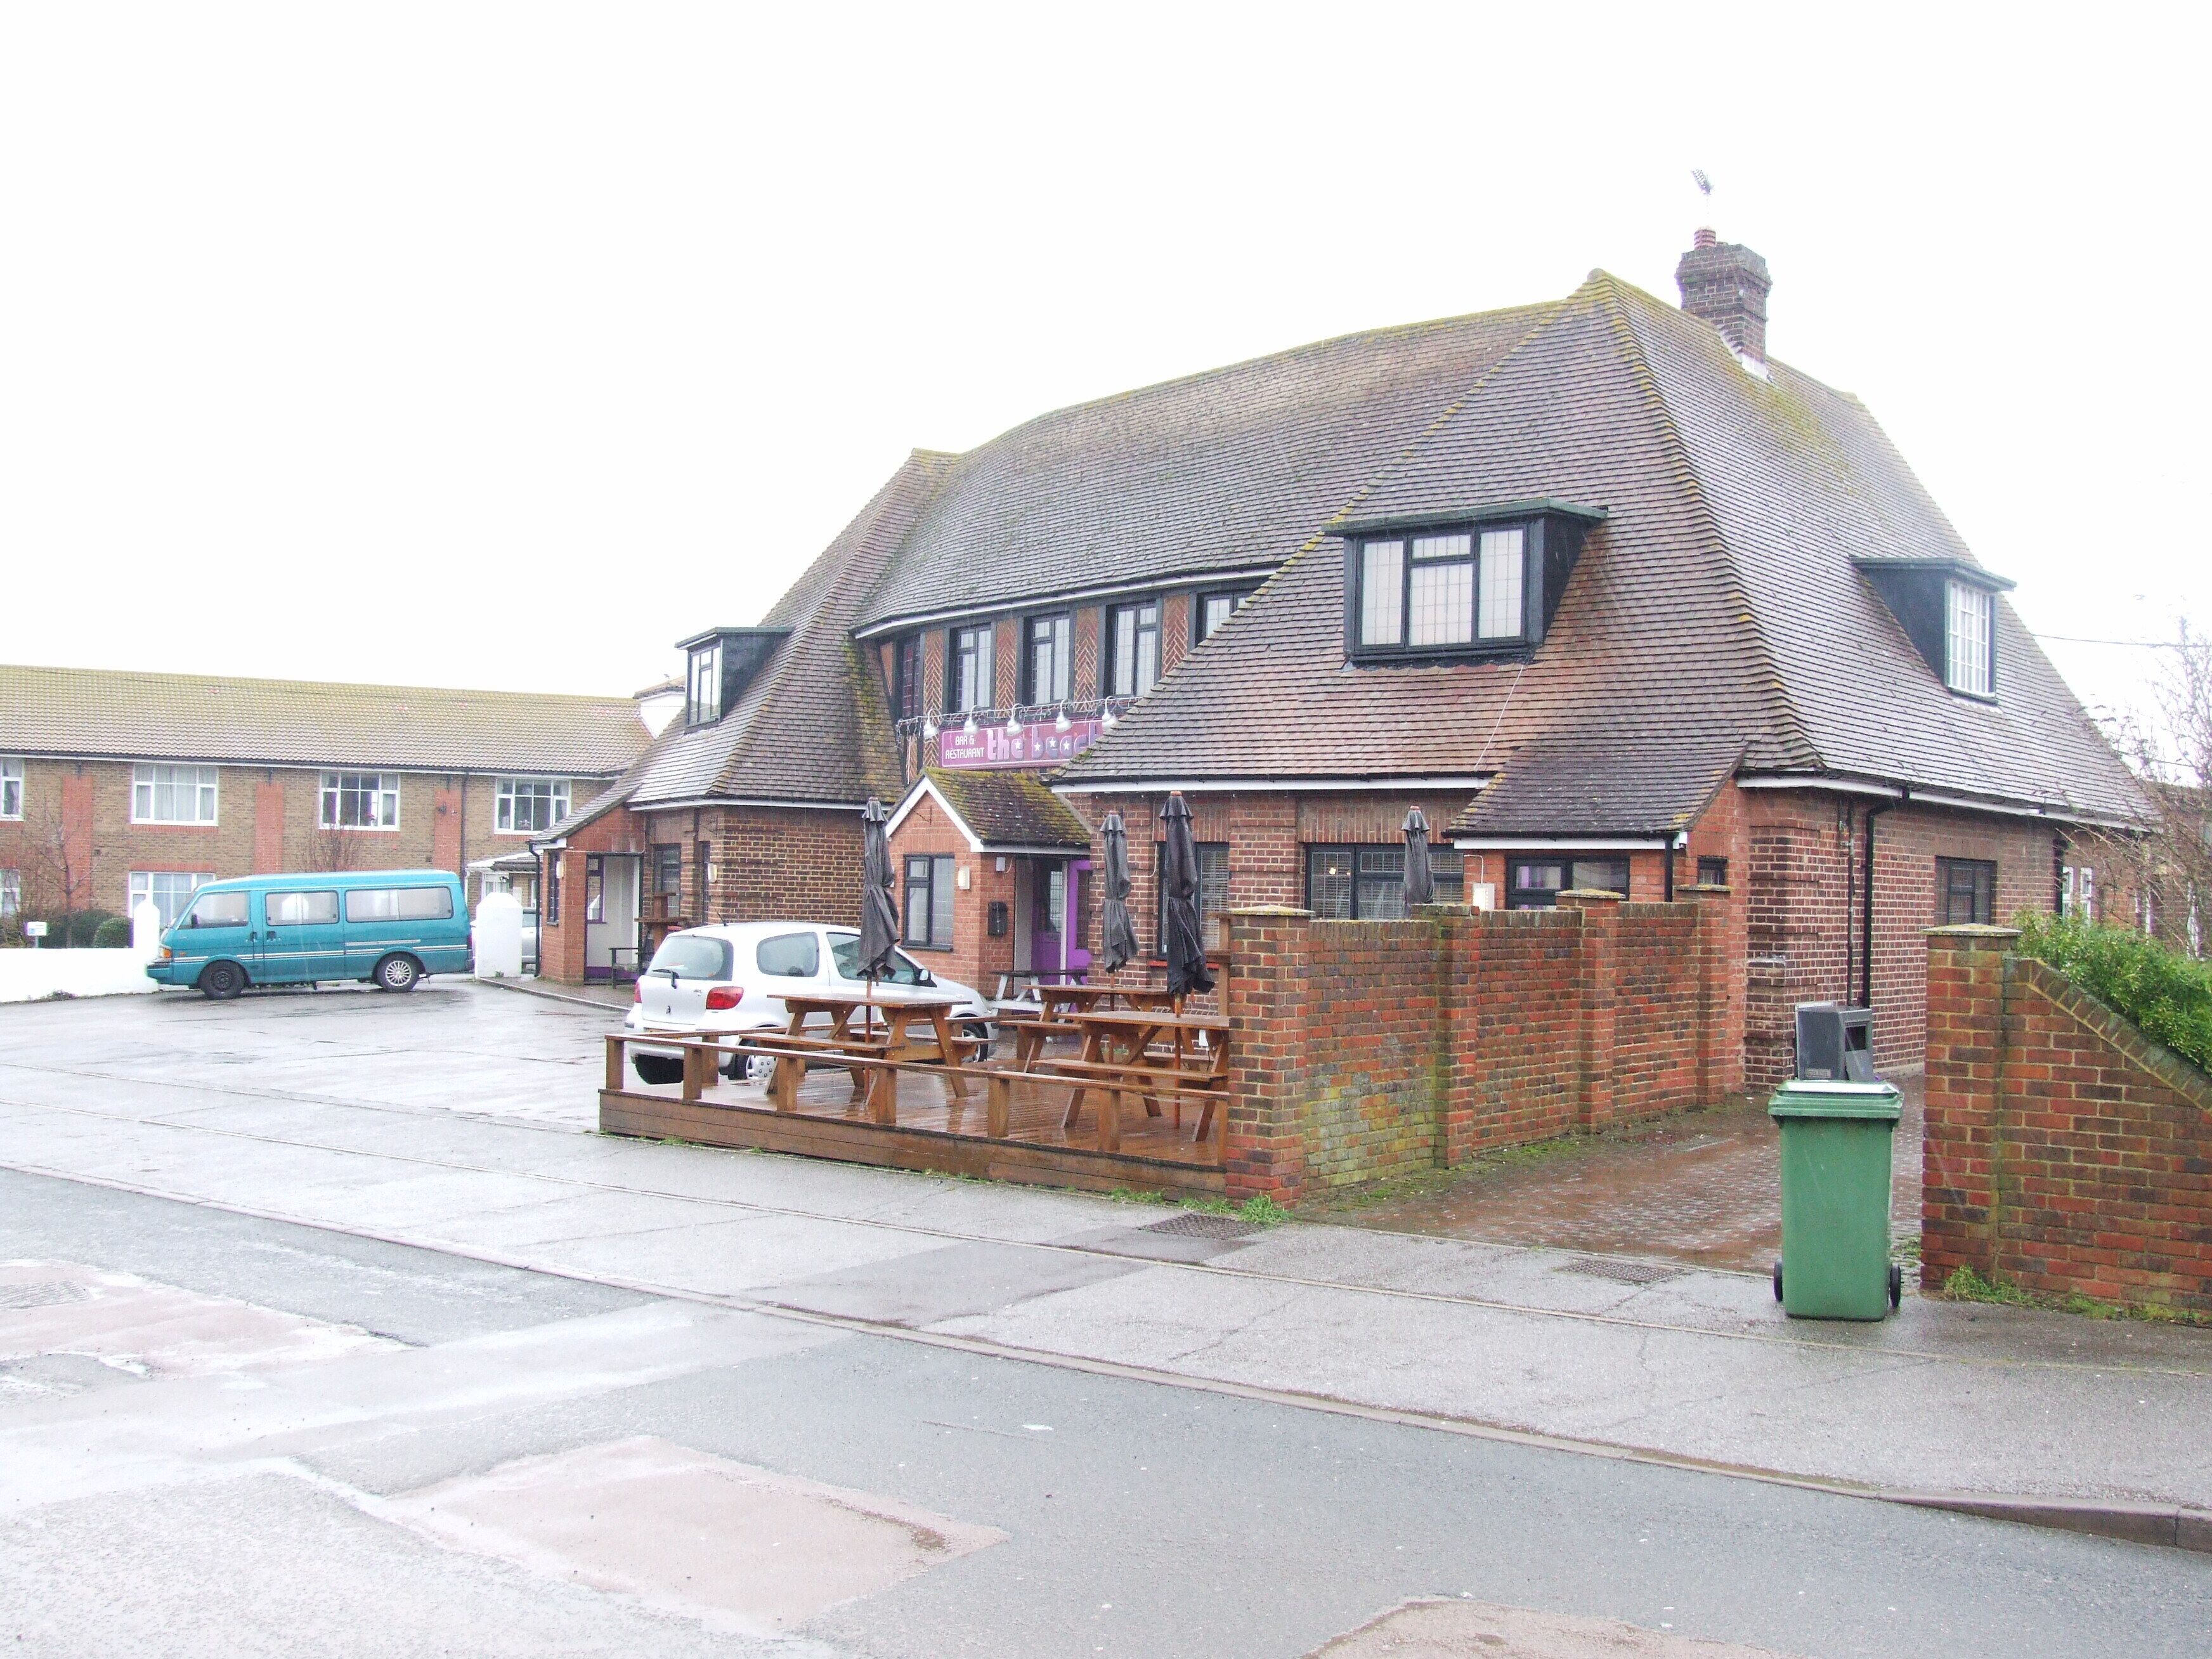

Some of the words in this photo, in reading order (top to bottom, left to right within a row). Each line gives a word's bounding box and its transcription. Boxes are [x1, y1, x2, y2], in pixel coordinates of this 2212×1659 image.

[955, 736, 968, 746] BAR
[969, 735, 975, 745] &
[987, 729, 1024, 760] the
[946, 747, 985, 760] RESTAURANT
